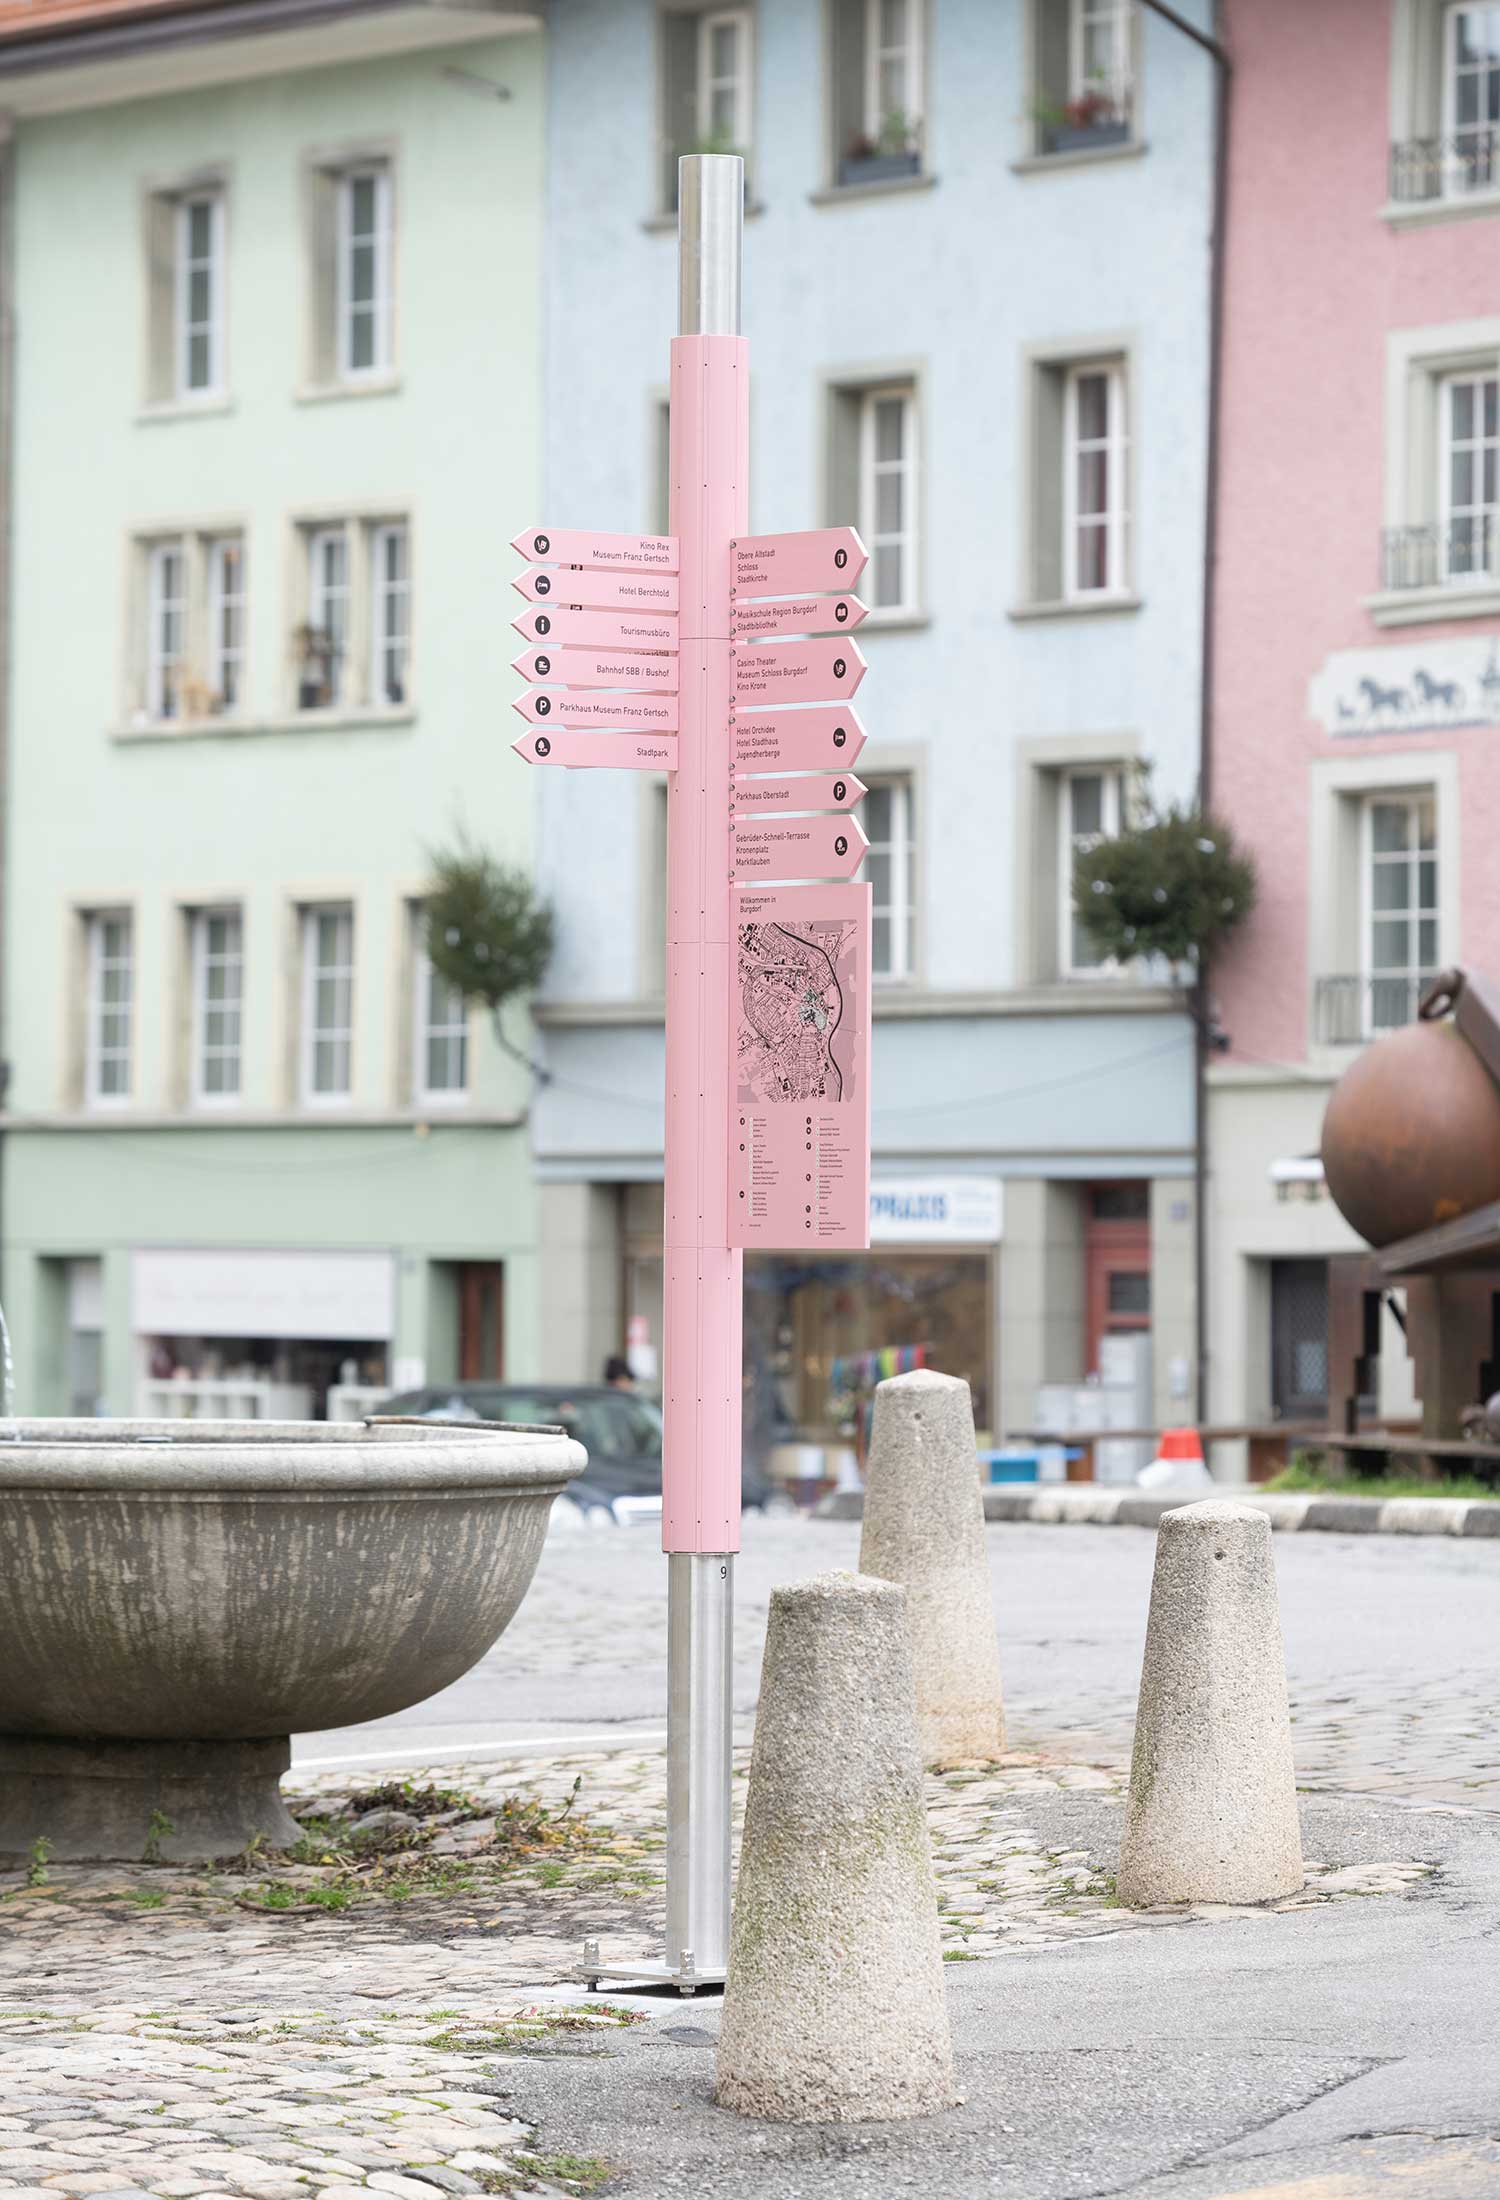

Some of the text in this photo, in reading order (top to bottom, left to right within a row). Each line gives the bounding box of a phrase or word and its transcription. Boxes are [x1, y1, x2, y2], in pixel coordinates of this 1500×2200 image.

[640, 542, 670, 551] Kino Rex
[593, 551, 670, 563] Museum Franz Gertsch
[738, 549, 775, 560] Obere Altstadt
[738, 564, 758, 572] Schloss
[738, 574, 768, 583] Stadtkirche
[619, 586, 670, 597] Hotel Berchtold
[738, 605, 817, 618] Musikschule Region Burgdorf
[738, 621, 778, 631] Stadtbibliothek
[620, 626, 670, 637] Tourismusbüro
[737, 658, 776, 667] Casino Theater
[596, 665, 624, 675] Bahnhof
[626, 667, 640, 676] SBB
[646, 668, 670, 677] Bushof
[737, 667, 808, 679] Museum Schloss Burgdorf
[750, 682, 766, 690] Krone
[560, 703, 669, 717] Parkhaus Museum Franz Gertsch
[752, 726, 775, 734] Orchidee
[752, 738, 778, 746] Stadthaus
[637, 748, 668, 758] Stadtpark
[736, 750, 780, 760] Jugendherberge
[736, 791, 789, 800] Parkhaus Oberstadt
[736, 846, 769, 854] Kronenplatz
[736, 858, 770, 866] Marktlauben
[740, 906, 761, 914] Burgdorf
[721, 1566, 726, 1579] 9
